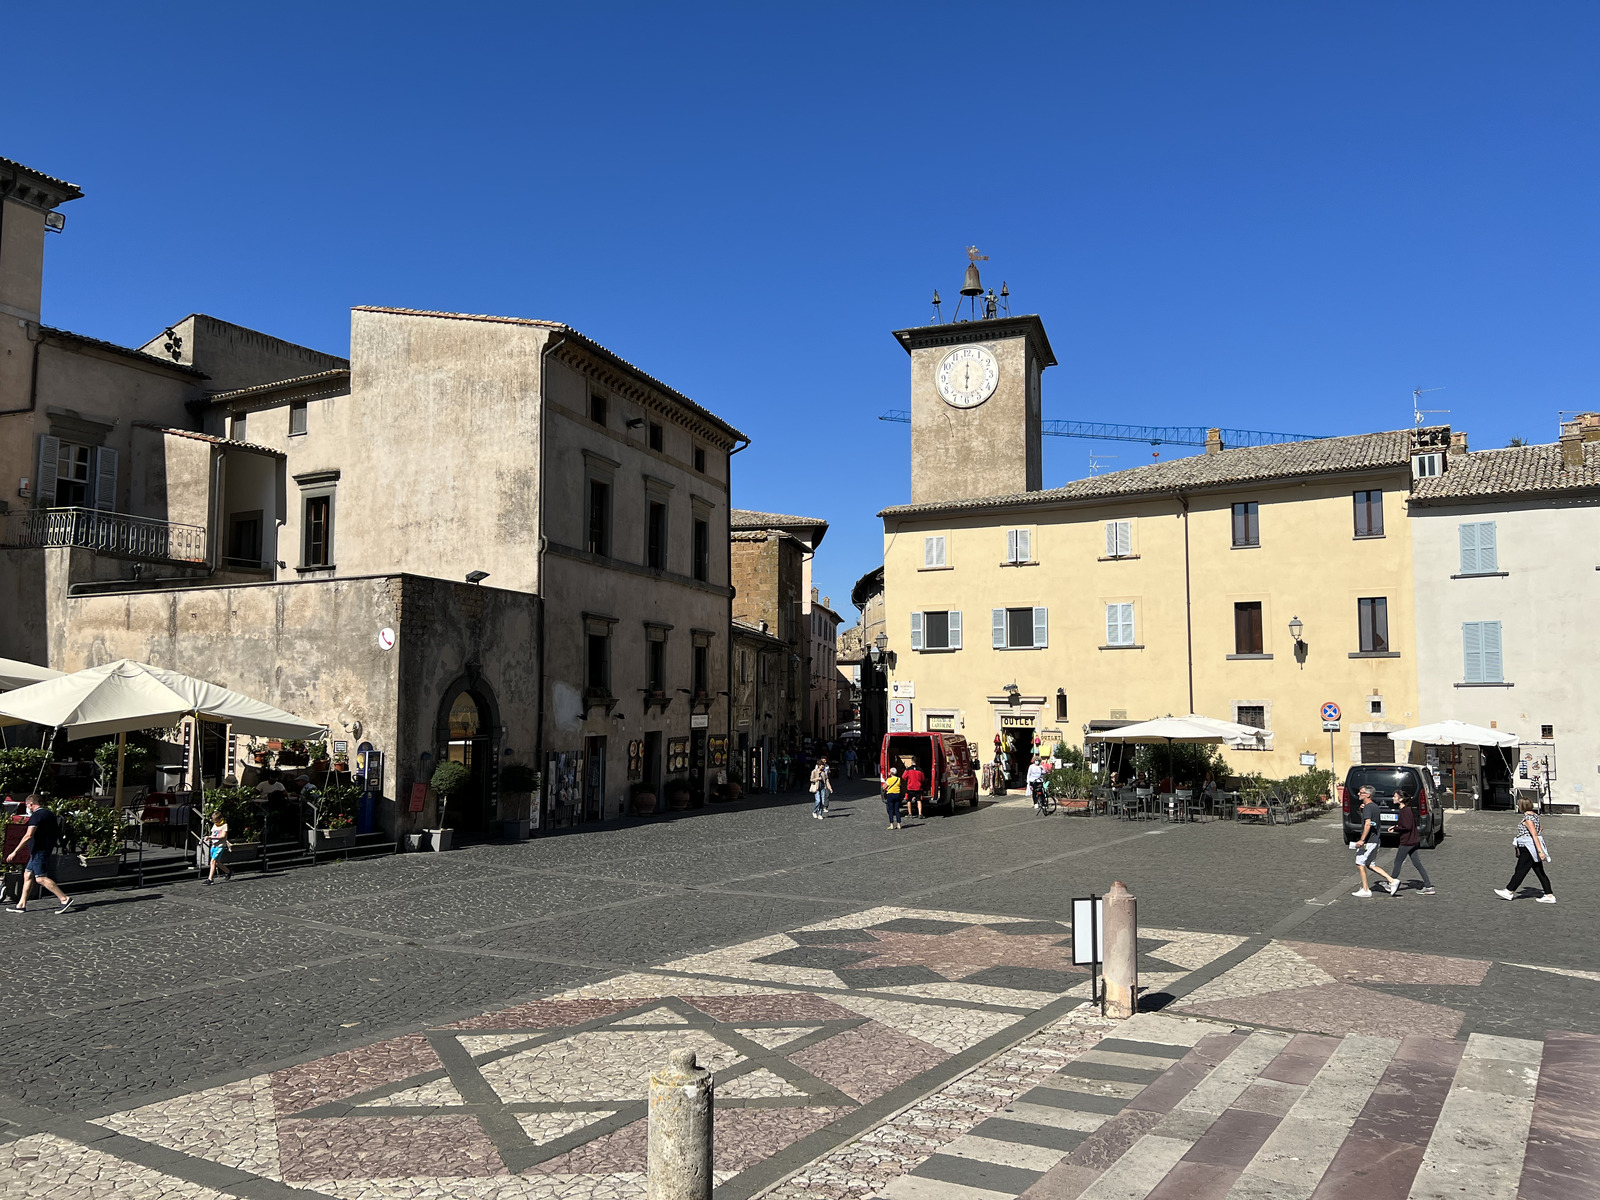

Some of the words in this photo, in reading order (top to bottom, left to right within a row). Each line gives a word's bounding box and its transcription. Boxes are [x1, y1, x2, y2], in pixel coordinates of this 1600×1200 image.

[952, 353, 959, 361] 11
[963, 349, 972, 357] 12
[985, 358, 991, 367] 2
[943, 363, 951, 371] 10
[941, 374, 946, 382] 9
[988, 370, 994, 378] 3
[943, 385, 949, 394] 8
[985, 382, 991, 391] 4
[952, 394, 957, 402] 7
[976, 391, 982, 400] 5
[964, 396, 970, 404] 6
[1004, 718, 1035, 726] OUTLET
